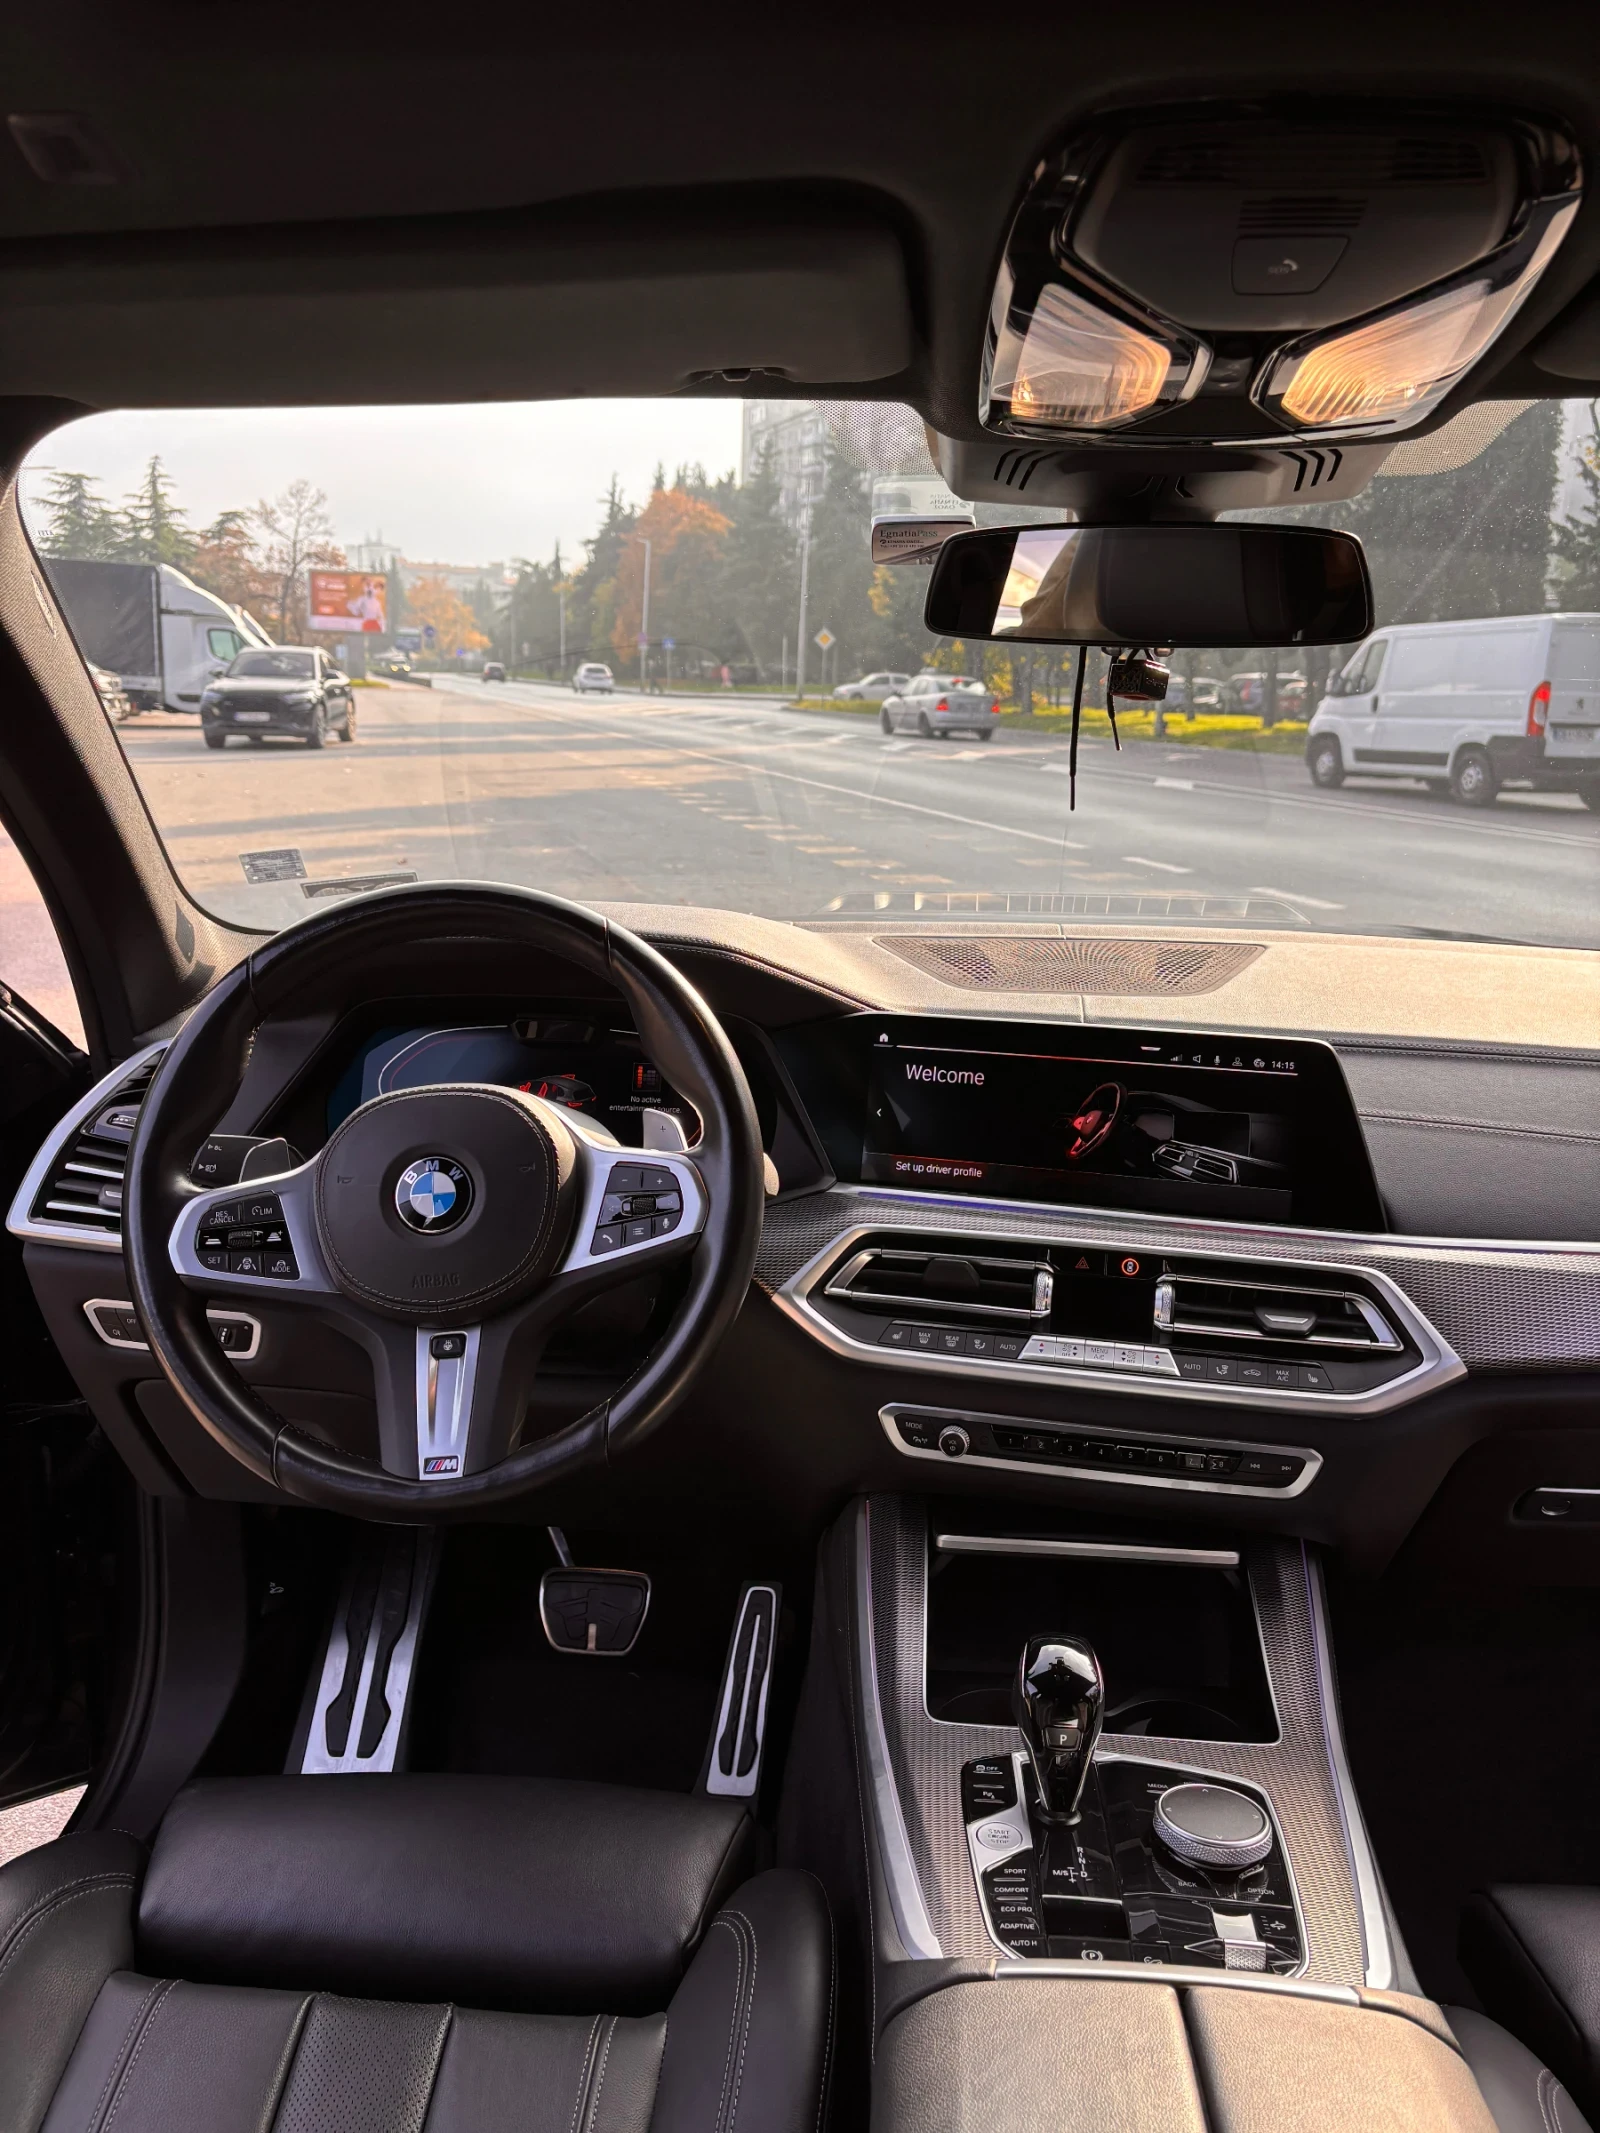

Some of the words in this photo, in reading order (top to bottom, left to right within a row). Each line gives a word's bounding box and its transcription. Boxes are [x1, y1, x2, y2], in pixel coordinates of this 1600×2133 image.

[1271, 1060, 1295, 1070] 14:15
[906, 1063, 985, 1086] Welcome
[630, 1095, 640, 1103] No
[641, 1096, 662, 1104] active
[404, 1160, 464, 1185] BMW
[895, 1161, 911, 1171] Set
[912, 1163, 924, 1174] up
[926, 1163, 952, 1175] driver
[953, 1166, 983, 1178] profile
[215, 1210, 228, 1218] RES
[260, 1207, 273, 1215] LIM
[209, 1215, 236, 1225] CANCEL
[207, 1256, 221, 1264] SET
[271, 1265, 291, 1273] MODE
[411, 1273, 461, 1289] AIRBAG
[999, 1343, 1017, 1351] AUTO
[1090, 1347, 1109, 1355] MENU
[1183, 1363, 1201, 1371] AUTO
[905, 1421, 923, 1430] MODE
[1059, 1734, 1068, 1745] P
[1247, 1887, 1275, 1895] OPTION
